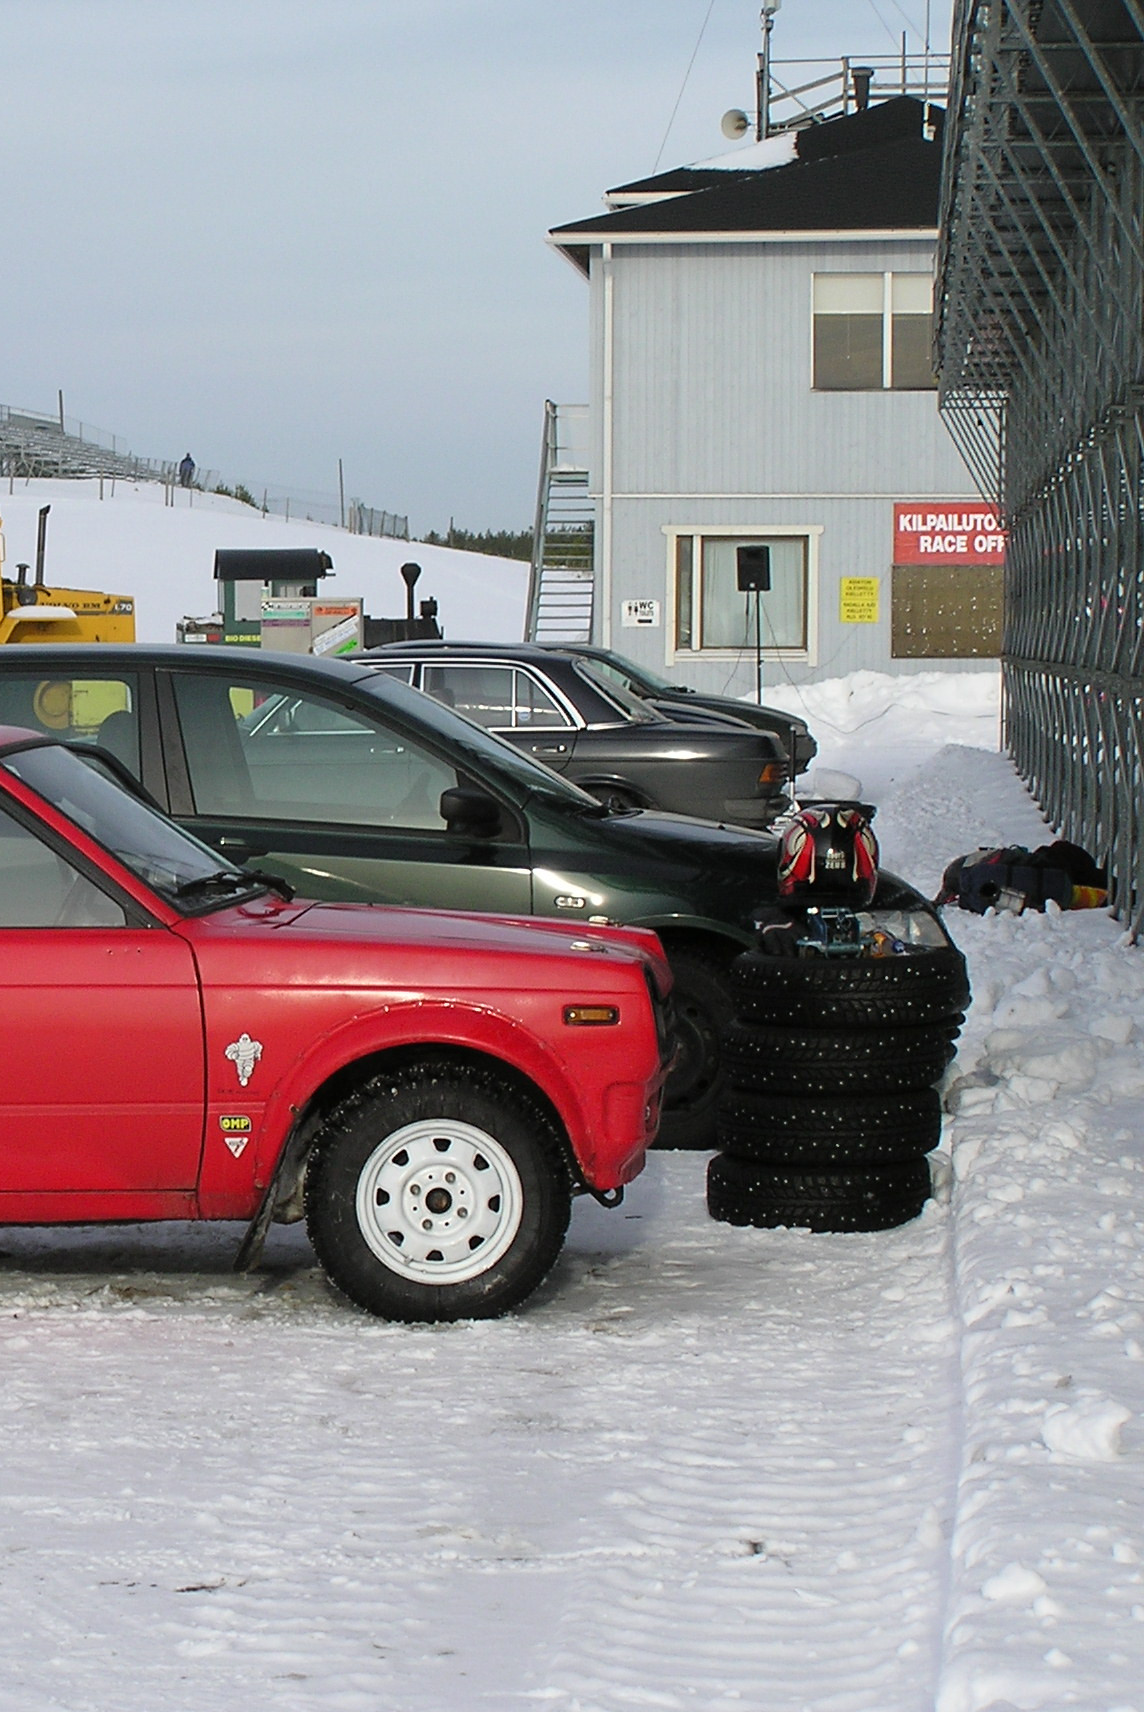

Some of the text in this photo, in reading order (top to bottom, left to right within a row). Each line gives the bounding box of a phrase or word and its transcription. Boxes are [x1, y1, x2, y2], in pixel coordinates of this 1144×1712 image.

[898, 513, 1002, 532] KILPAILUTO
[919, 534, 968, 553] RACE
[115, 603, 133, 611] L70
[639, 601, 654, 609] WC
[222, 1118, 249, 1129] OMP
